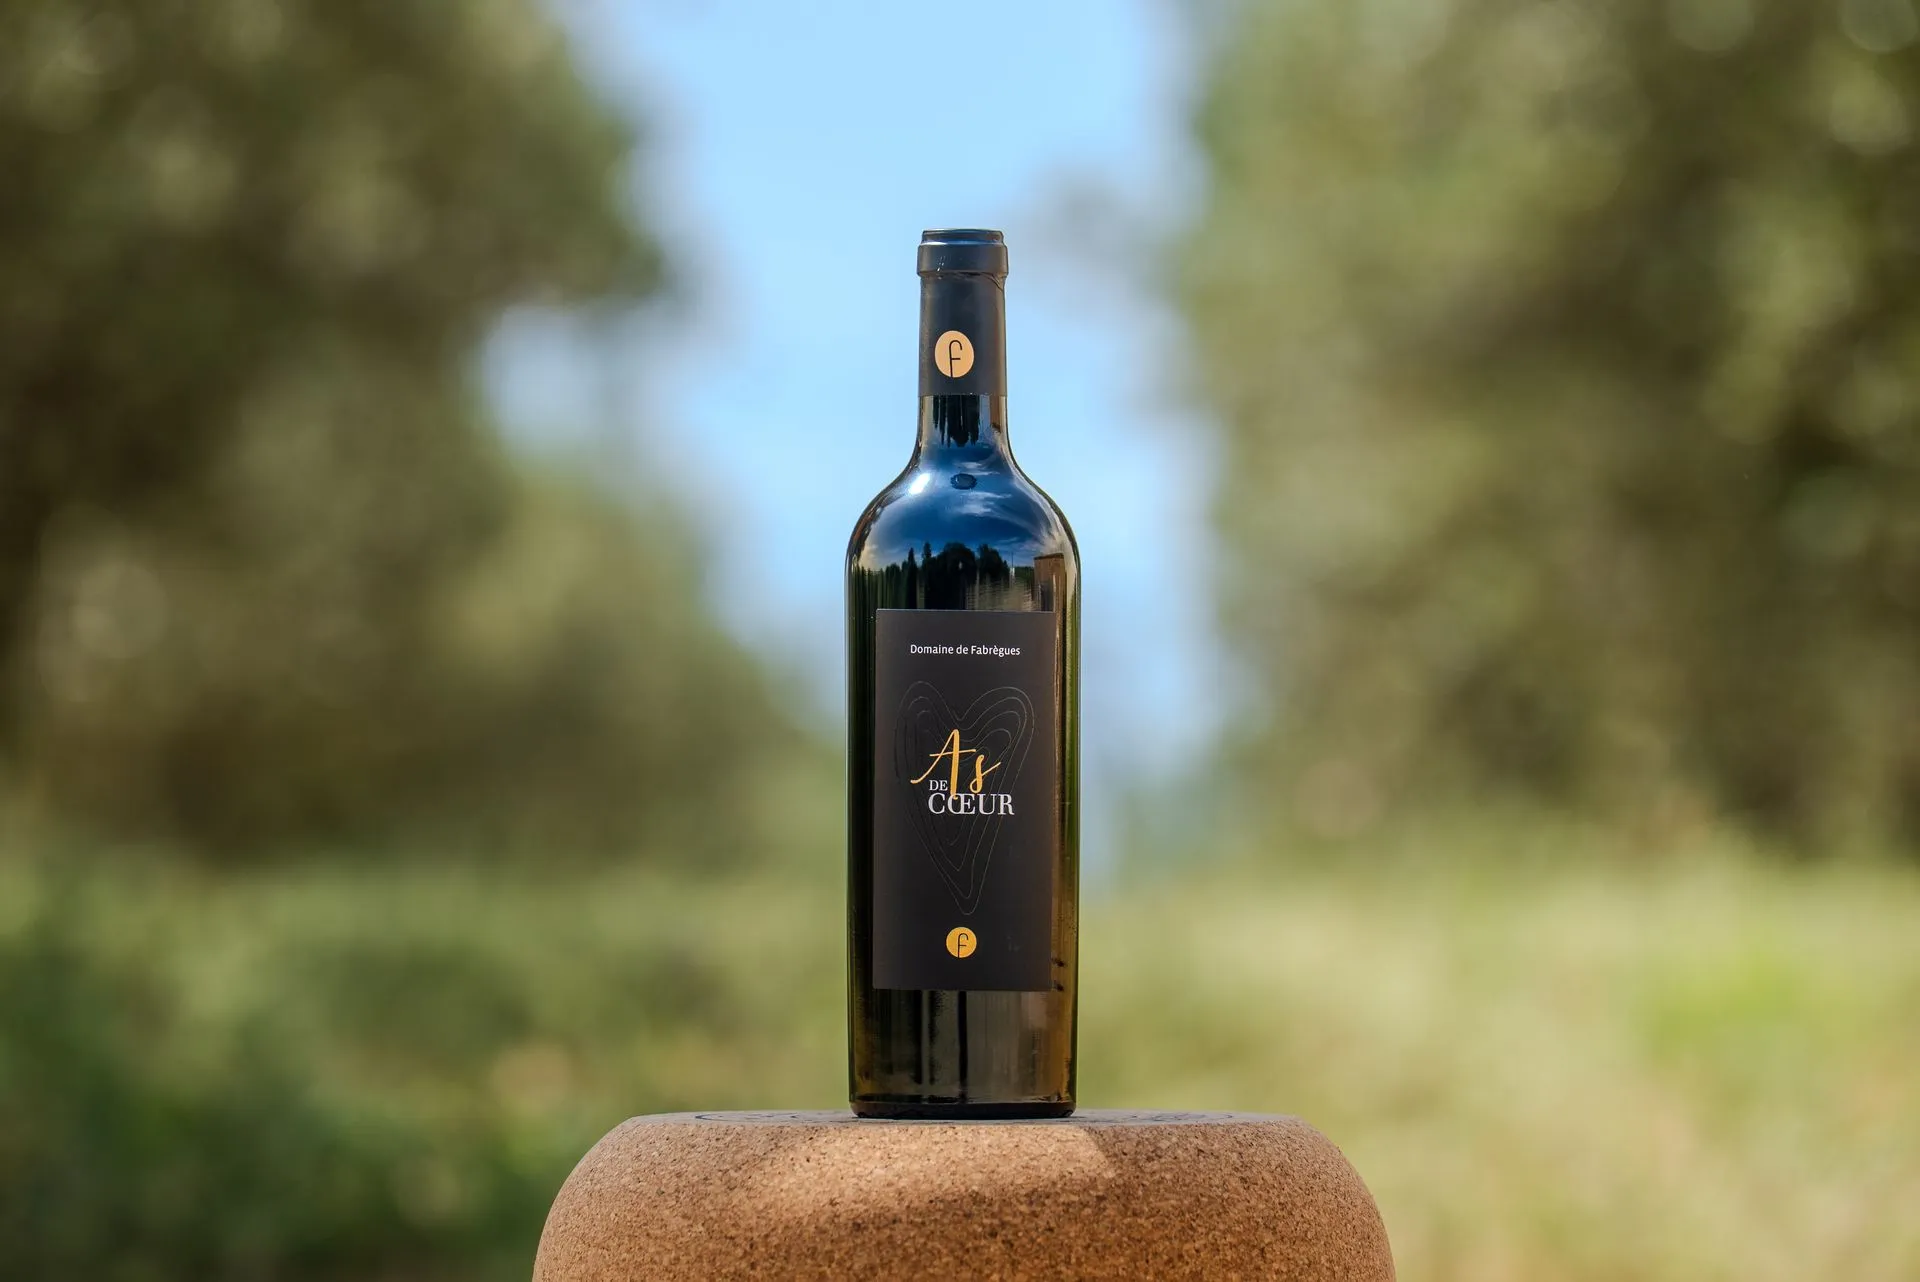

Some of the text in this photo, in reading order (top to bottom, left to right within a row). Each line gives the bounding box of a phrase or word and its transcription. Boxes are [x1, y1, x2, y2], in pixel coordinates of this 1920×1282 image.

[910, 644, 1021, 658] Domaine de Fabrègues
[910, 728, 1001, 800] As
[928, 779, 948, 791] DE
[928, 792, 1015, 816] CŒUR
